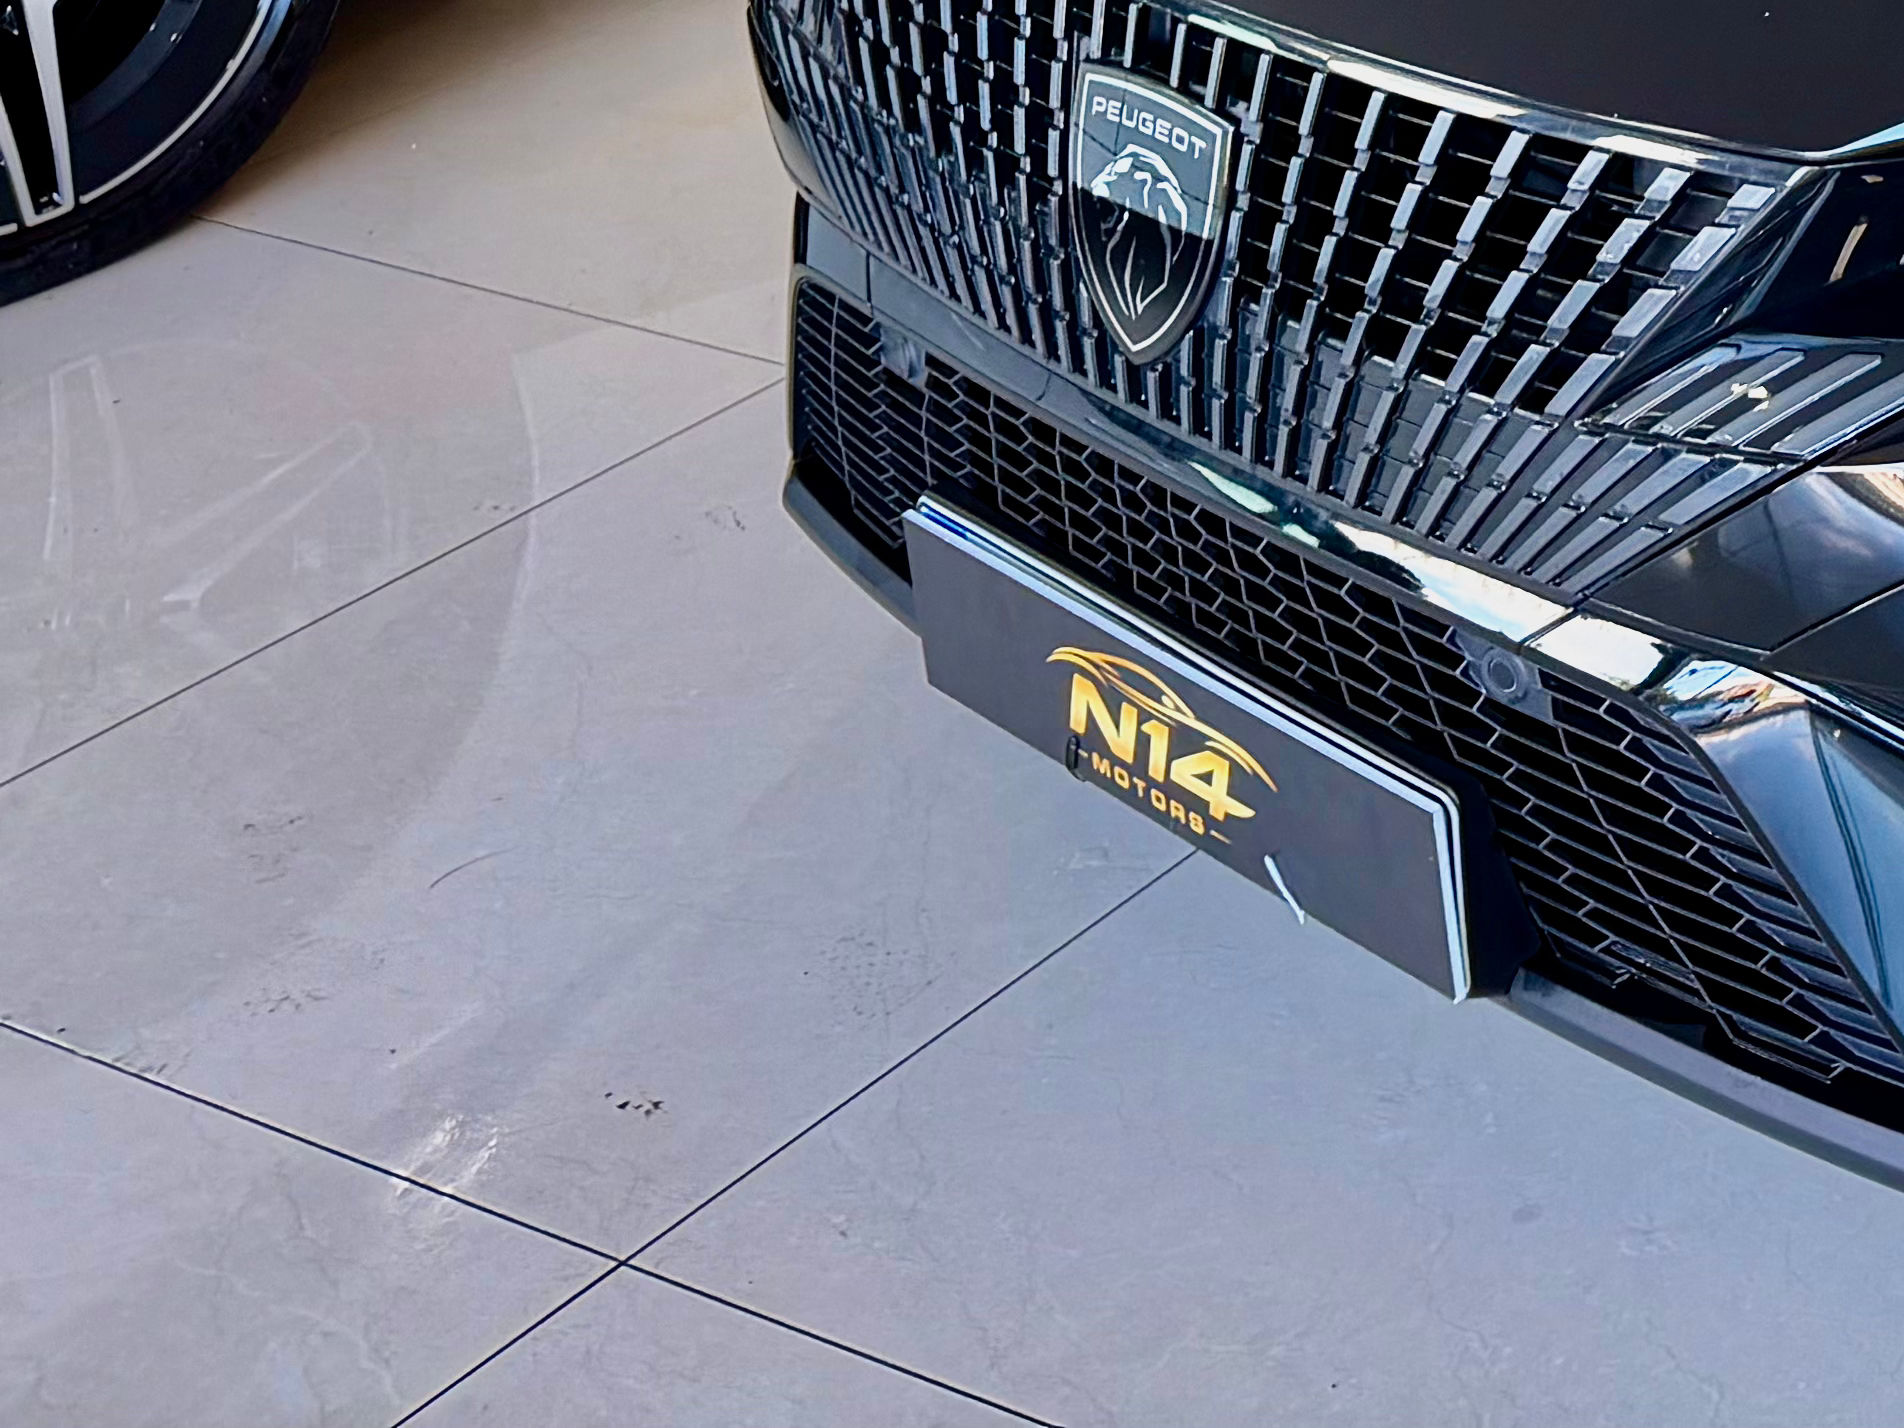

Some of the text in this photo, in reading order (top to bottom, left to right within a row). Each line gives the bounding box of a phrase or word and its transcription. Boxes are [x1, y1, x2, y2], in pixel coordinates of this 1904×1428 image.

[1089, 95, 1210, 159] PEUGEOT
[1068, 673, 1256, 823] N14
[1091, 750, 1205, 834] MOTORS
